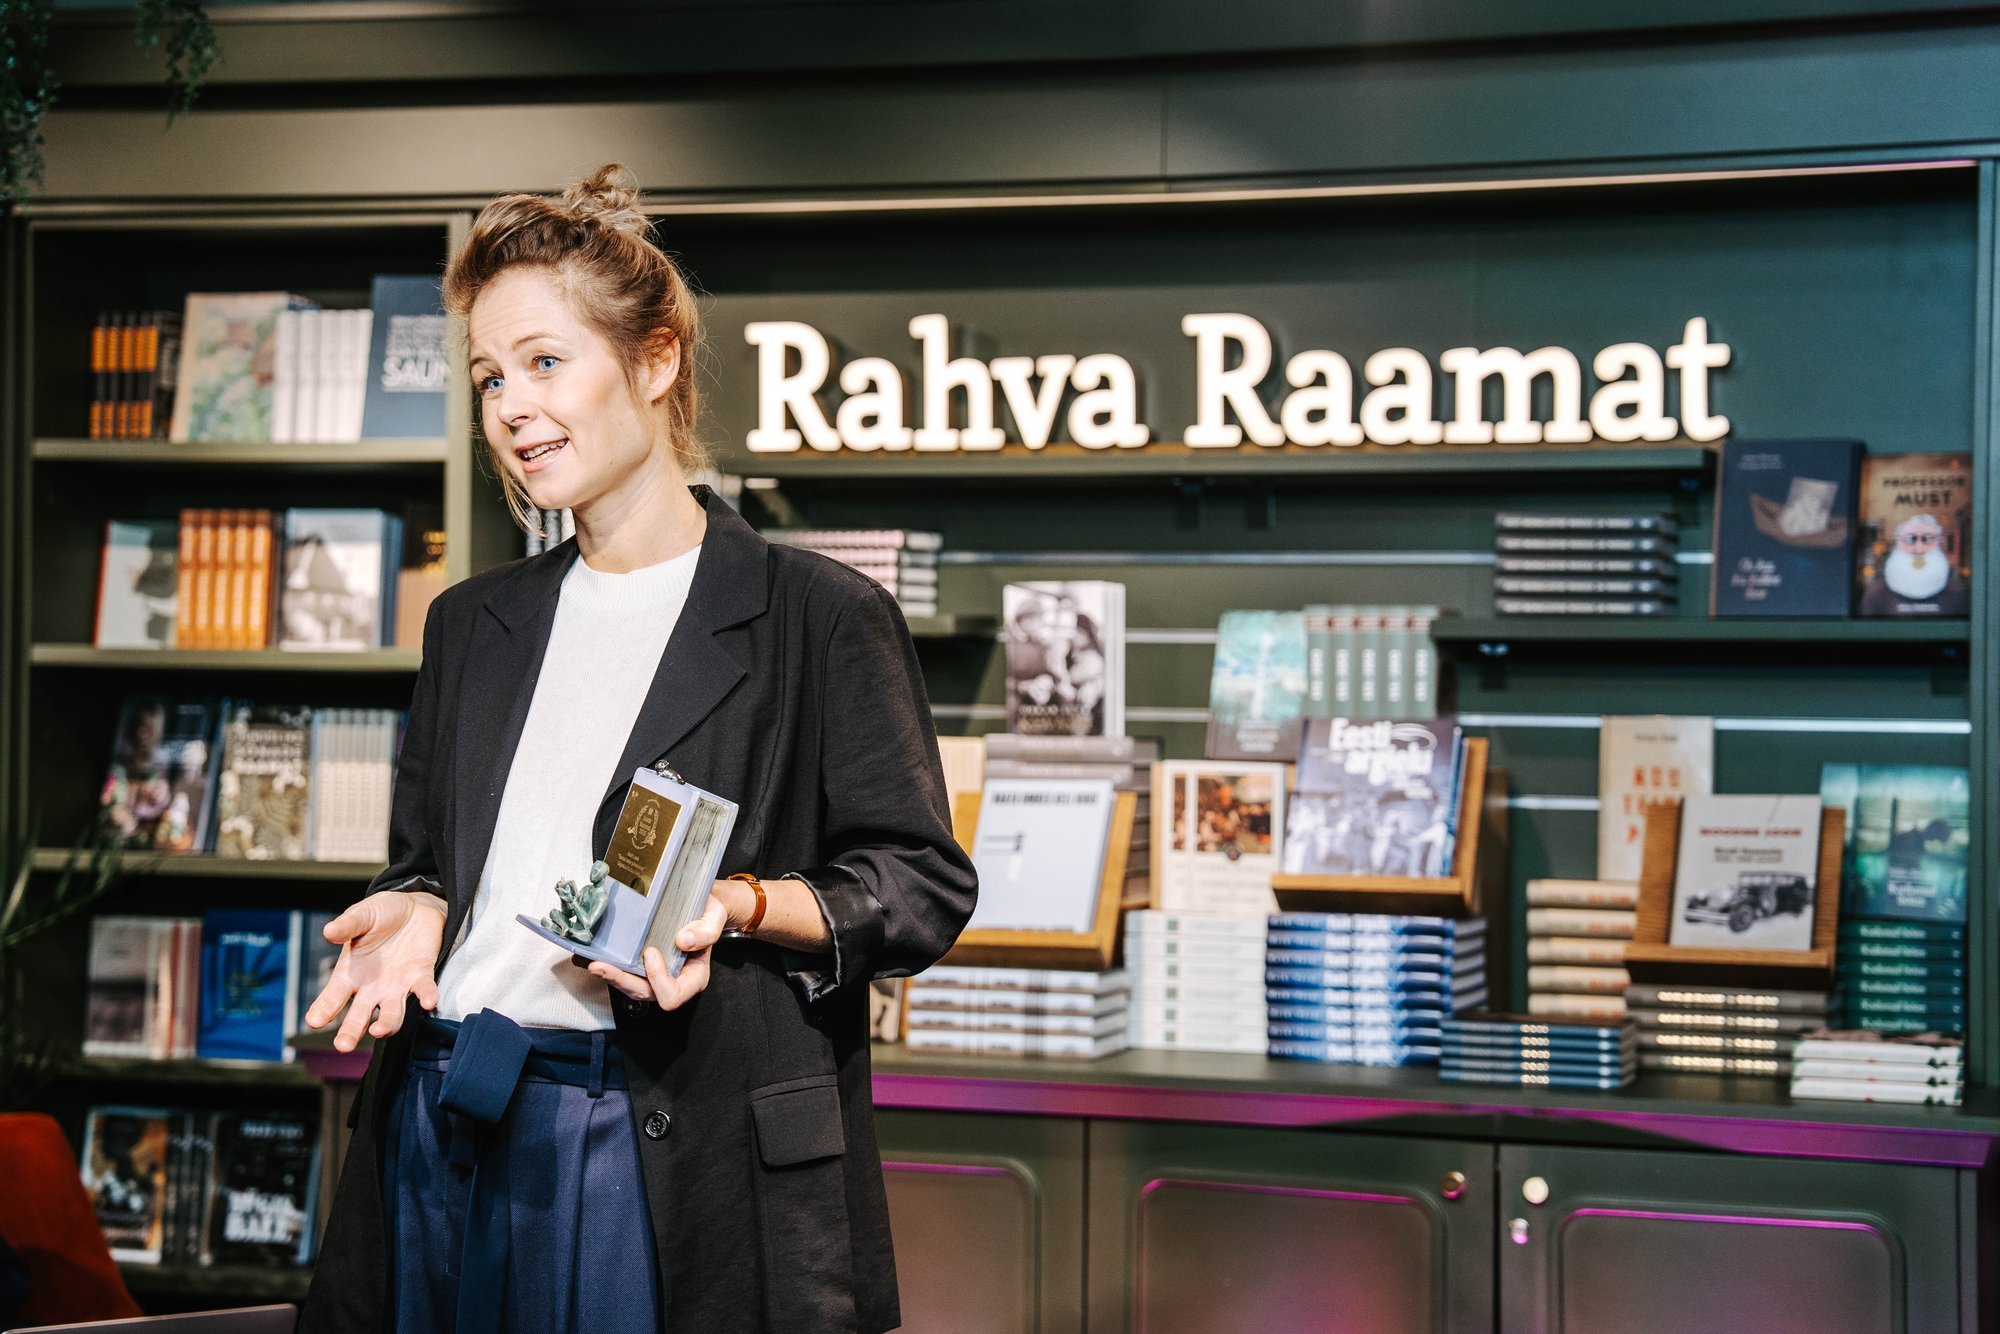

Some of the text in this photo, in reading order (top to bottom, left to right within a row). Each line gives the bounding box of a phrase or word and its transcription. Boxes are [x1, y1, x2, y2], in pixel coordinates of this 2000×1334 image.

[744, 312, 1731, 452] Rahva Raamat
[1894, 491, 1952, 506] MUST
